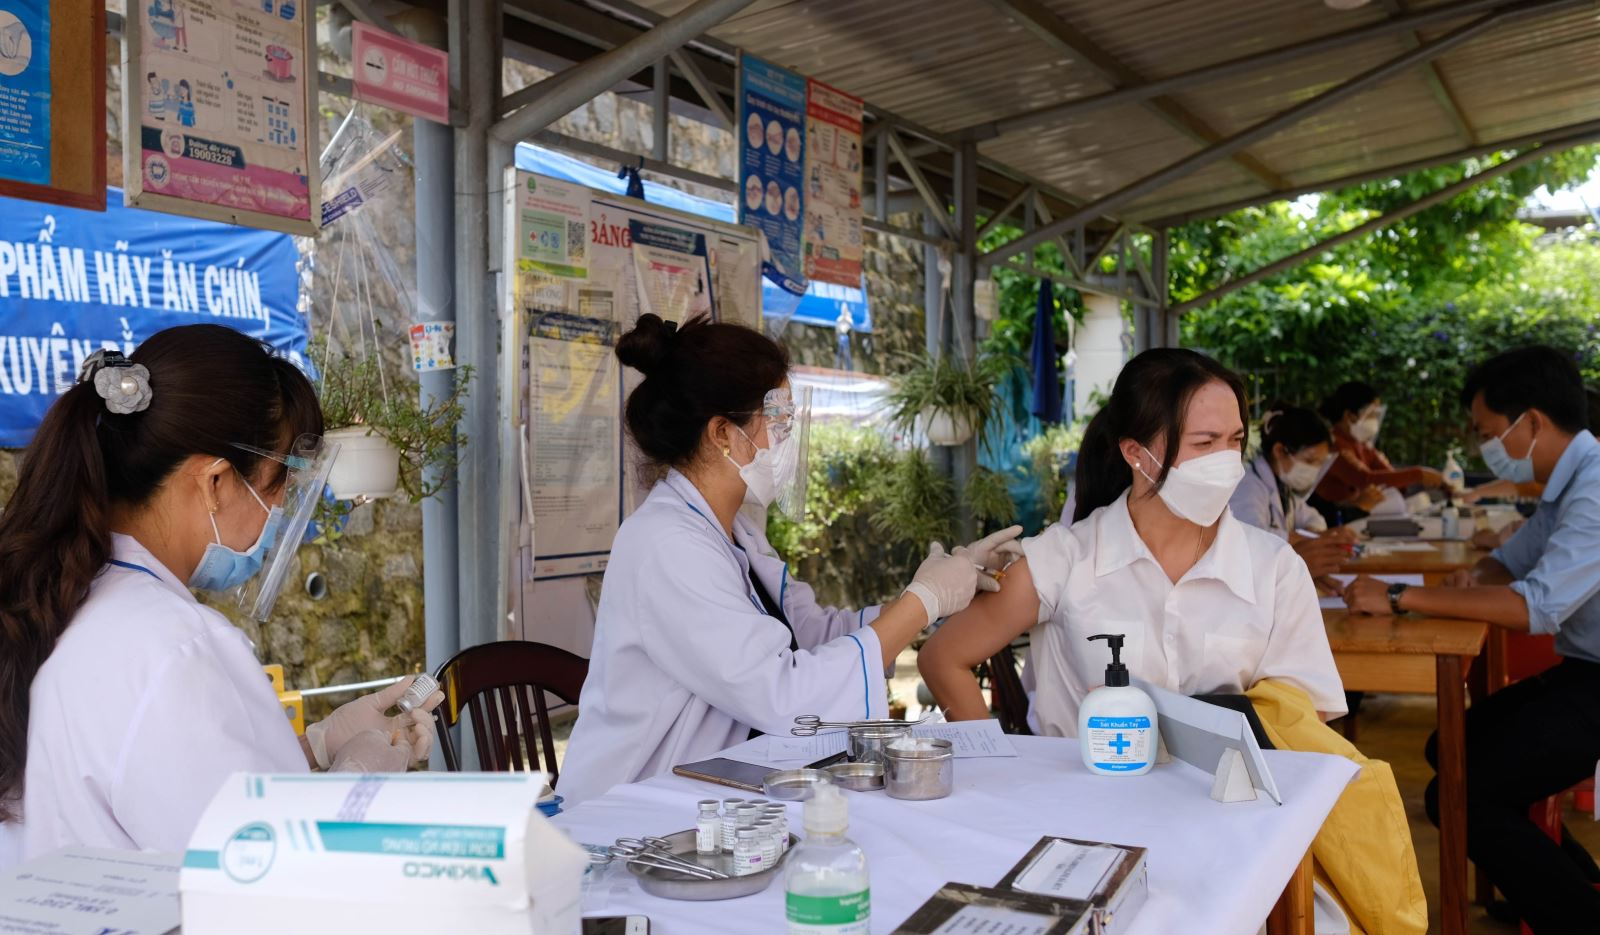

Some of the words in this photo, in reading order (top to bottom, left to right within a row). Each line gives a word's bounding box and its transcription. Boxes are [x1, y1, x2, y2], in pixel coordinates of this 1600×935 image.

[189, 147, 233, 166] 19003228
[0, 215, 90, 303] PHẨM
[95, 240, 151, 308] HÃY
[163, 248, 199, 313] ĂN
[205, 256, 270, 331] CHÍN,
